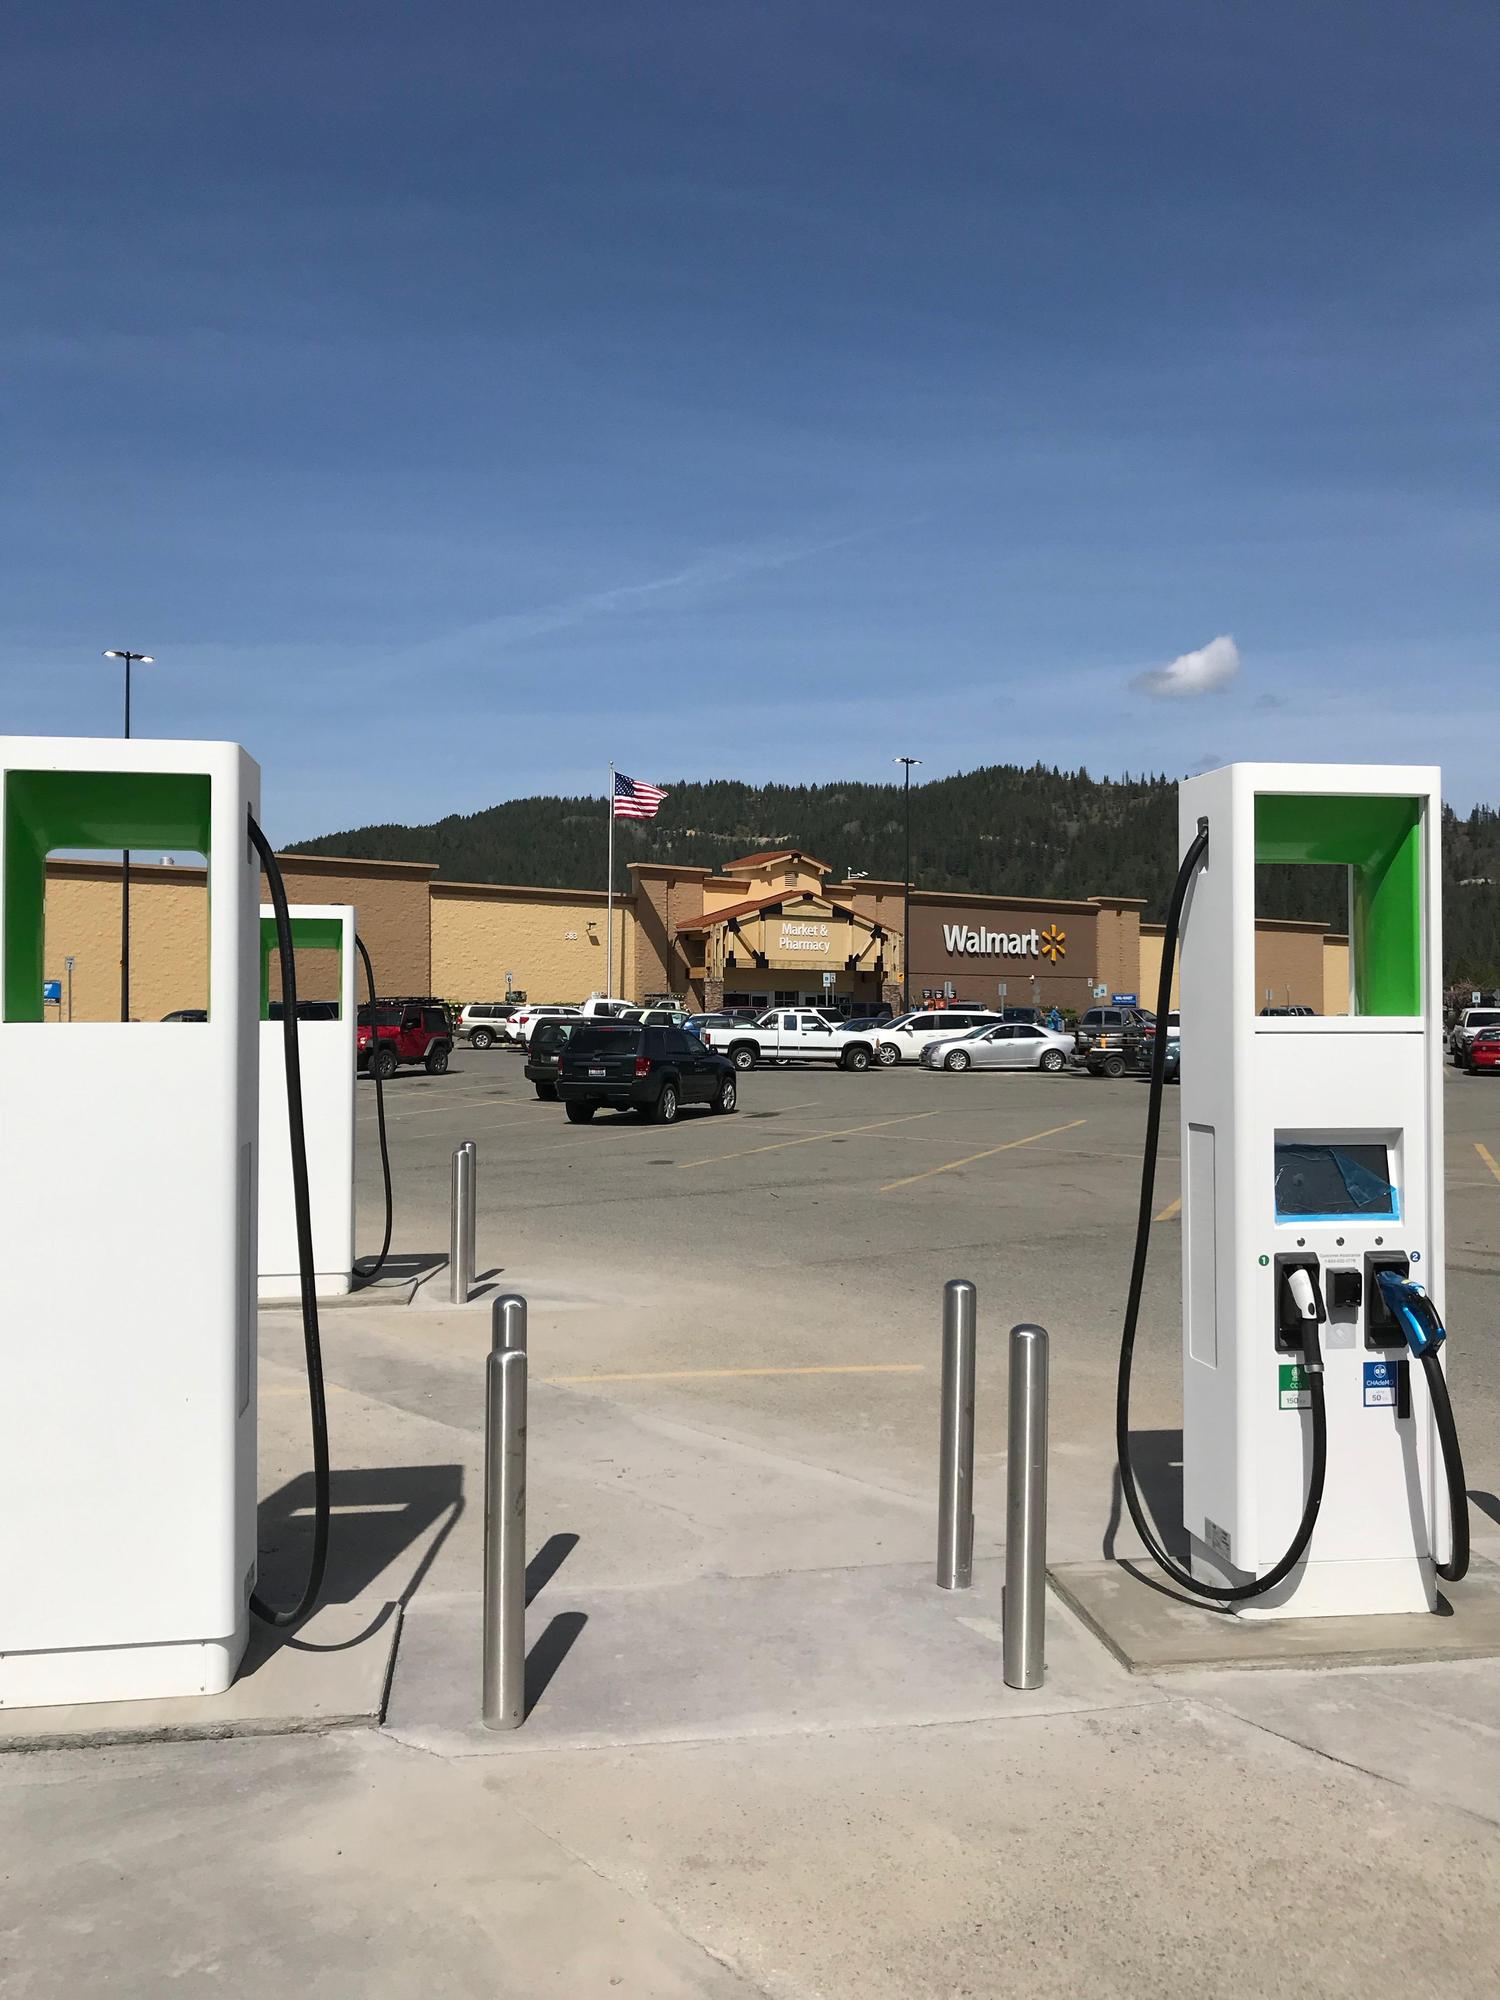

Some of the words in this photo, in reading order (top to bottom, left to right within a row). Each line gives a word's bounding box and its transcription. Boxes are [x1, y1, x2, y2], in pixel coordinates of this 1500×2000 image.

[782, 923, 818, 936] Market
[820, 924, 828, 937] &
[780, 936, 831, 953] Pharmacy
[943, 924, 1039, 955] Walmart
[1261, 1256, 1266, 1265] 1
[1412, 1252, 1419, 1261] 2
